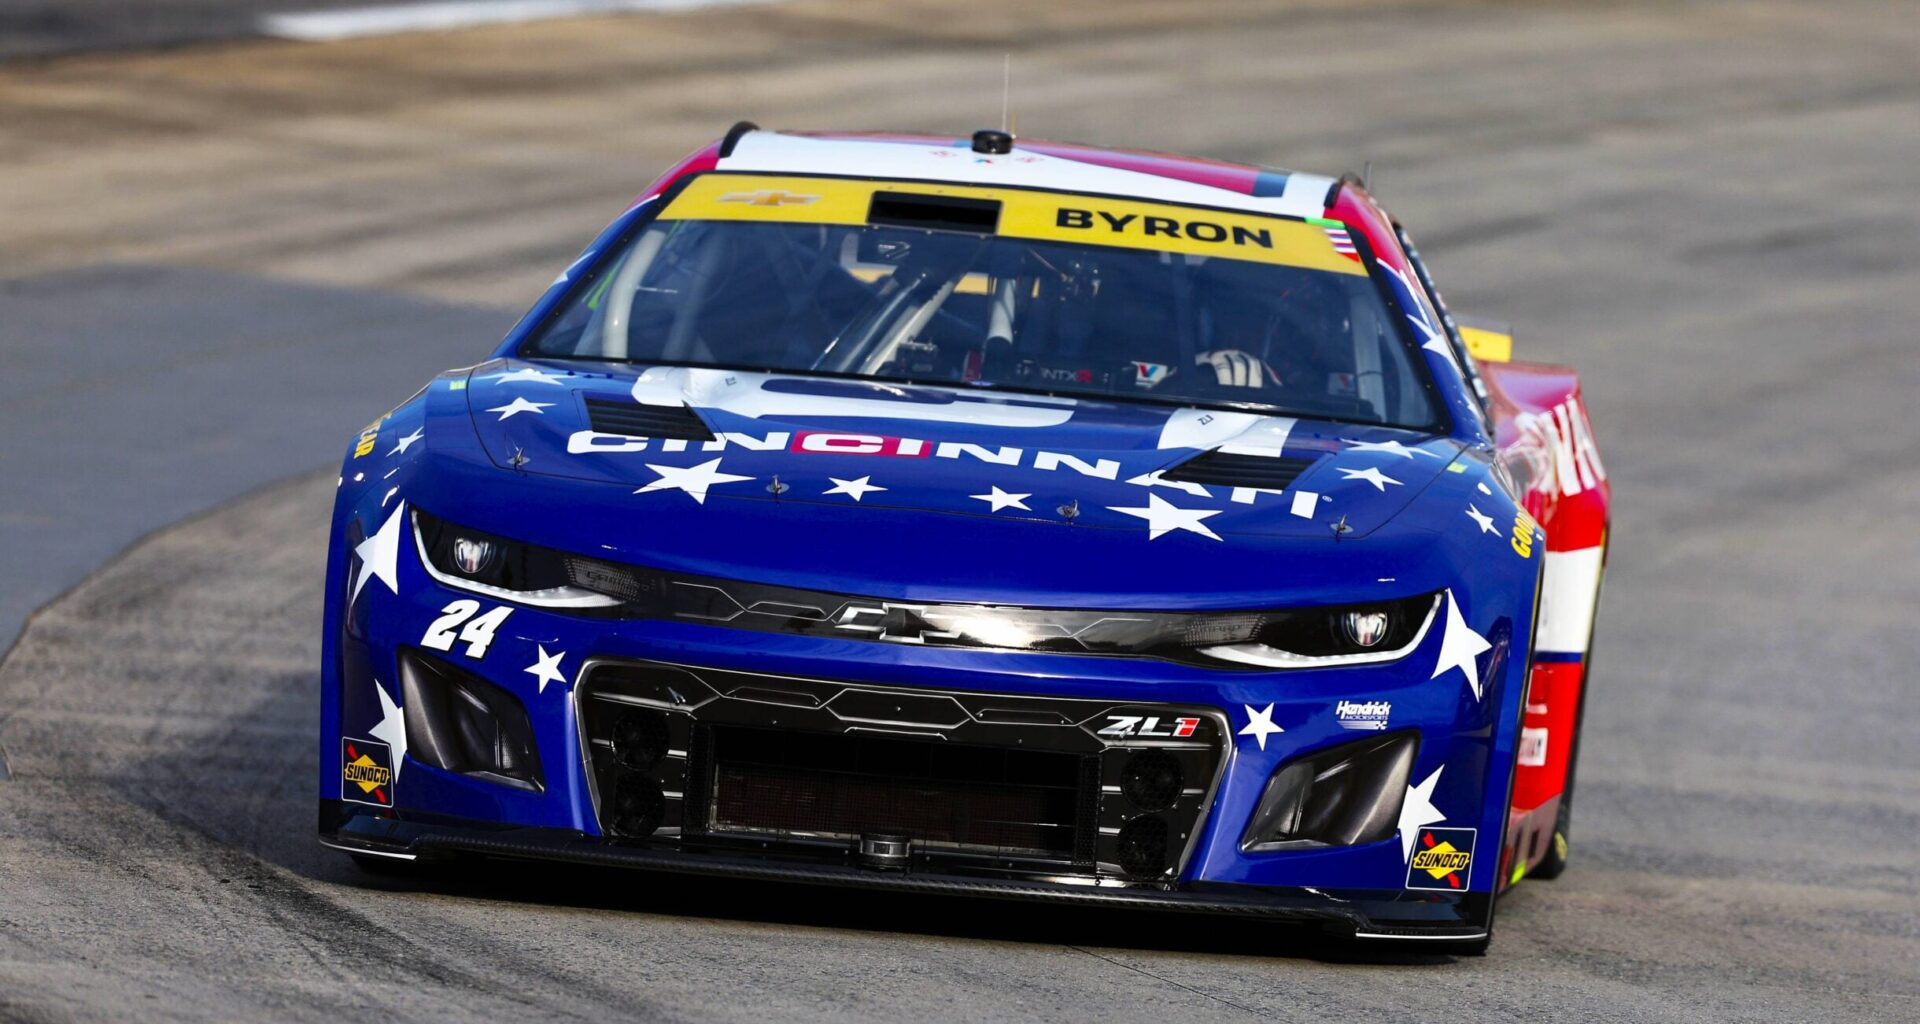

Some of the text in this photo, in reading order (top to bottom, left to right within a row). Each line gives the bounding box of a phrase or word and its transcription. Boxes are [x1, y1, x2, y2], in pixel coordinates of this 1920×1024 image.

[1055, 207, 1274, 250] BYRON
[420, 599, 516, 659] 24
[1335, 700, 1392, 719] Hendrick
[1096, 715, 1201, 738] ZL1
[346, 763, 388, 785] SUNOCO
[1415, 851, 1468, 870] SUNOCO
